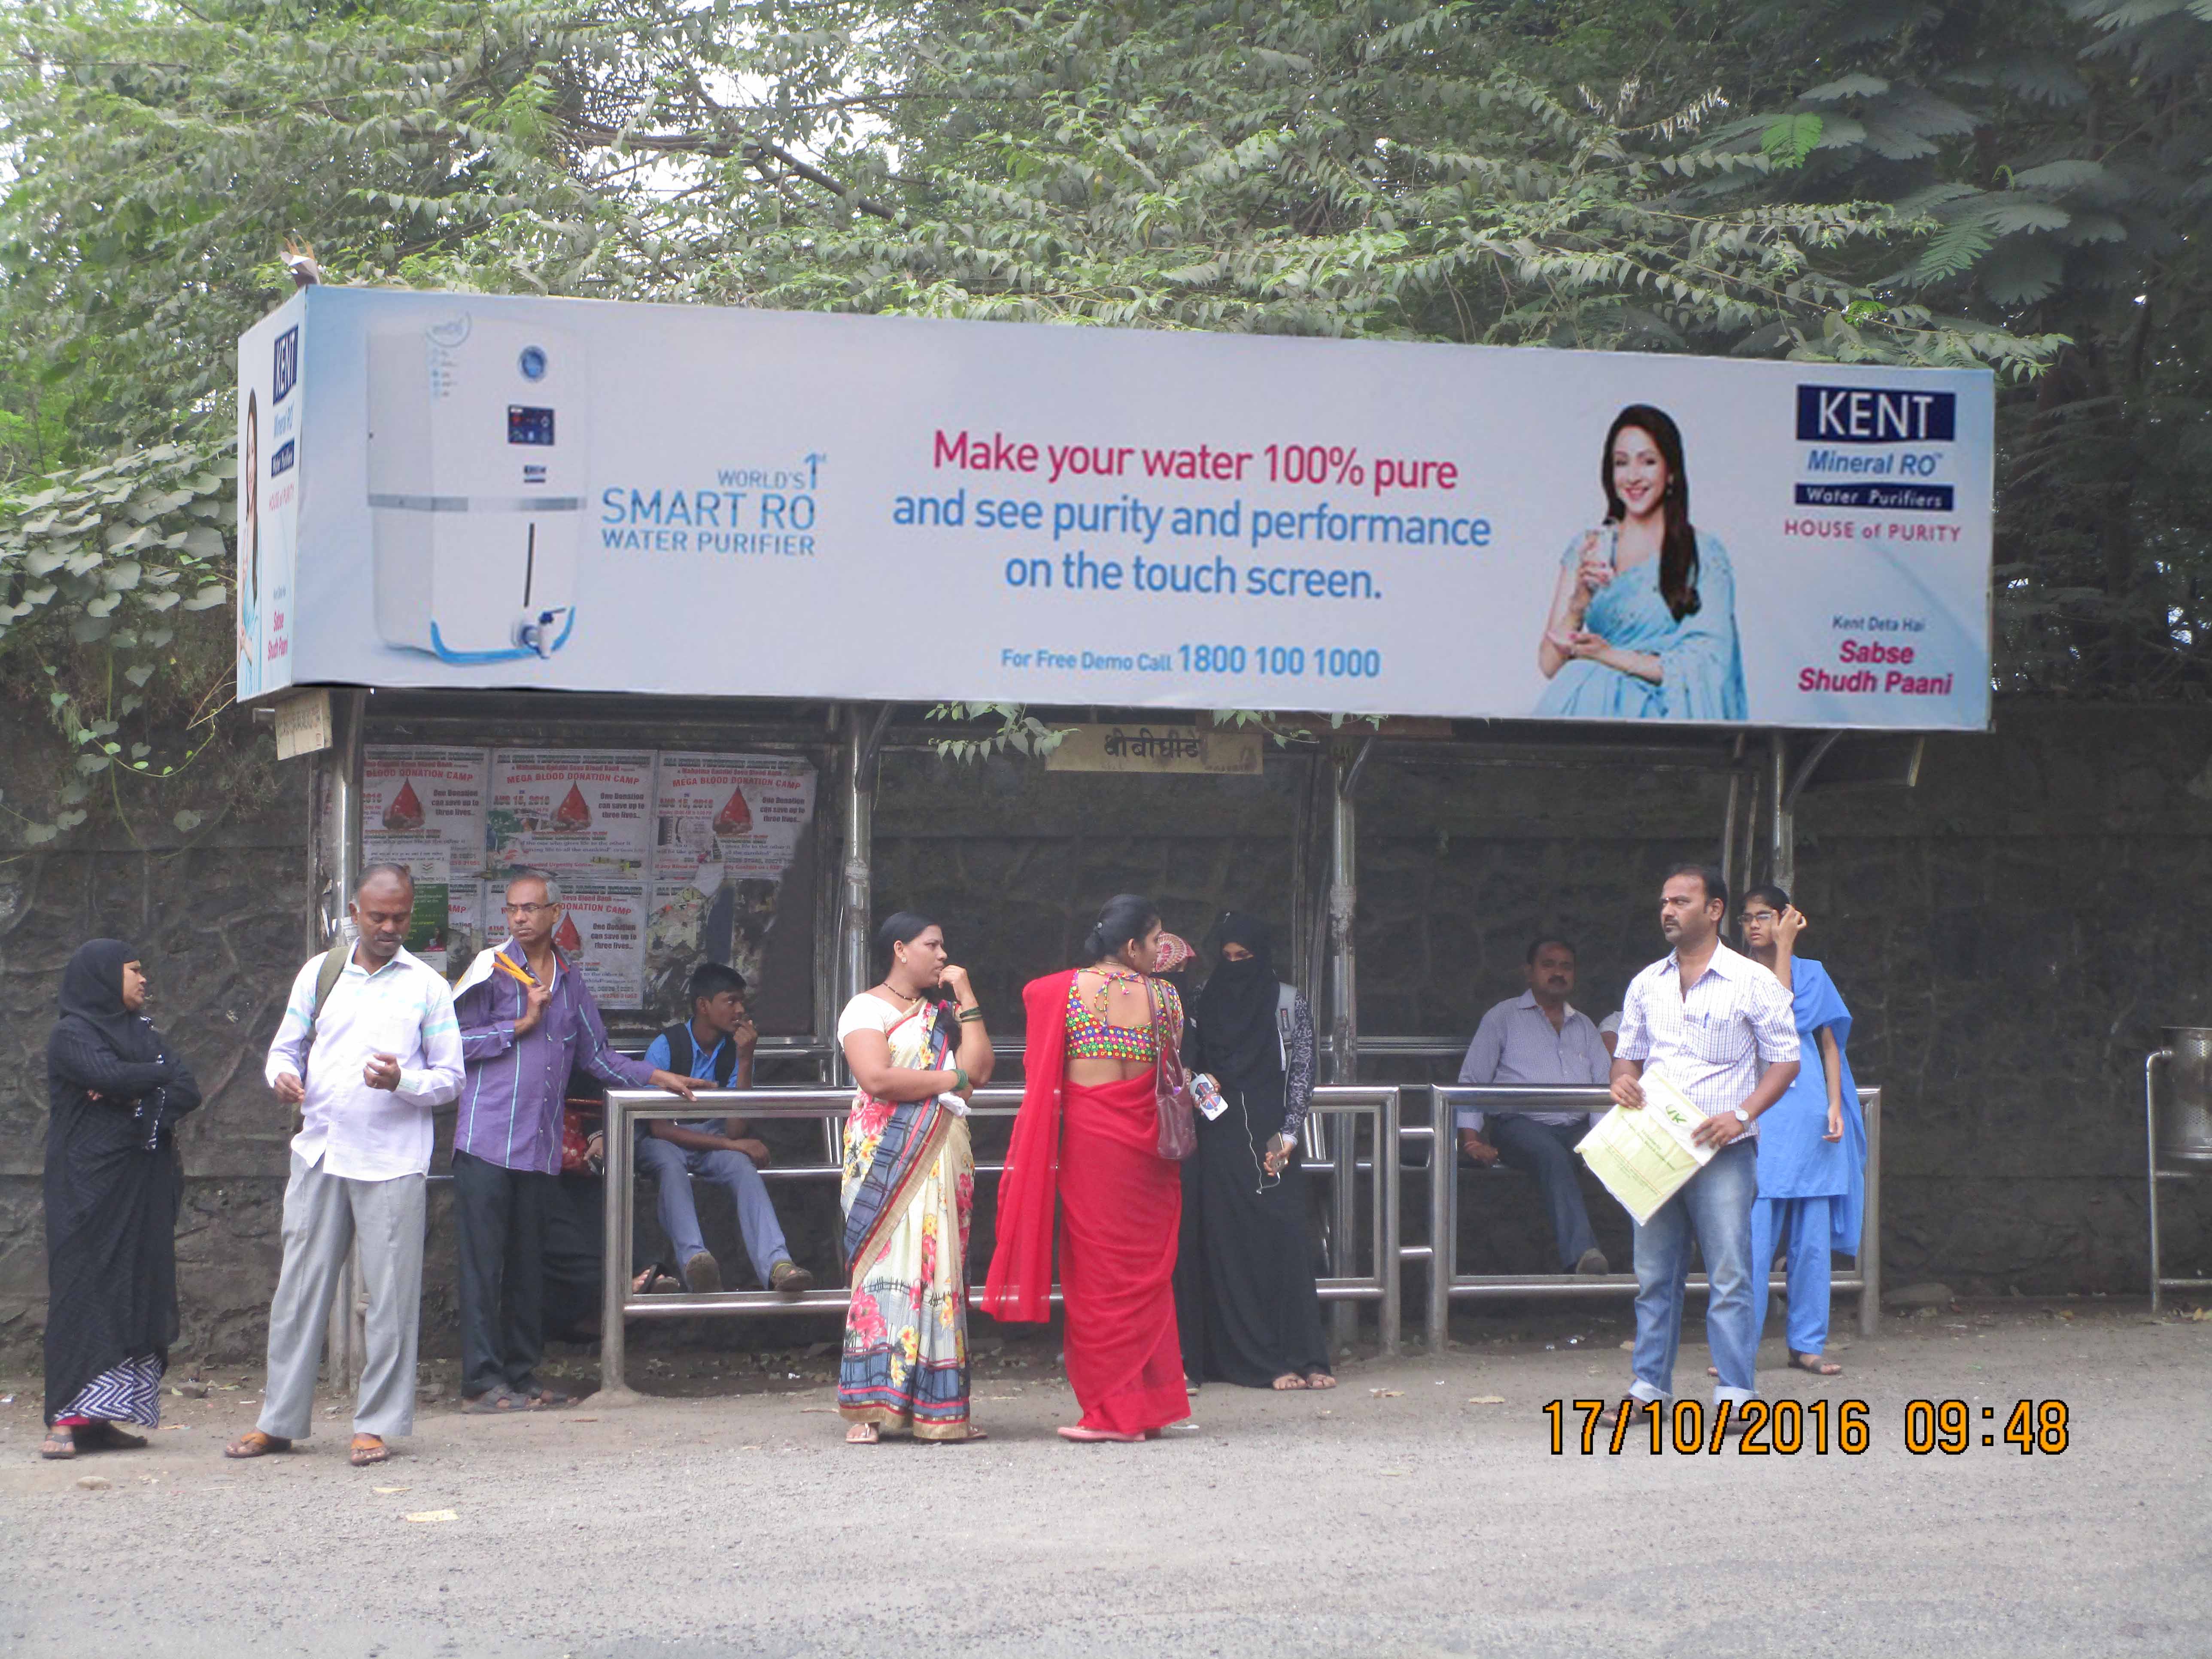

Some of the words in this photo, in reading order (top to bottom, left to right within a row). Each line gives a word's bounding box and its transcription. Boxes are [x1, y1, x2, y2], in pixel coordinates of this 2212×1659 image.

[276, 330, 295, 398] KENT
[1819, 391, 1933, 438] KENT
[933, 431, 1039, 474] Make
[1048, 446, 1134, 484] your
[1142, 445, 1253, 479] water
[1265, 445, 1365, 486] 100%
[1375, 459, 1458, 497] pure
[1808, 450, 1893, 474] Mineral
[717, 470, 805, 490] WORLD'S
[602, 488, 746, 528] SMART
[760, 493, 816, 530] RO
[1806, 487, 1859, 503] Water
[1868, 489, 1943, 507] Purifiers
[893, 489, 965, 526] and
[975, 499, 1043, 529] see
[1054, 495, 1164, 544] purity
[1171, 499, 1241, 537] and
[1252, 503, 1492, 548] performance
[1784, 520, 1854, 539] HOUSE
[1862, 524, 1881, 539] of
[1889, 523, 1961, 541] PURITY
[602, 529, 688, 552] WATER
[696, 531, 817, 556] PURIFIER
[1005, 558, 1051, 586] on
[1063, 550, 1123, 590] the
[1133, 555, 1236, 593] touch
[1247, 566, 1382, 599] screen.
[273, 610, 284, 632] Sabse
[1832, 616, 1865, 630] Kent
[1868, 617, 1899, 631] Deta
[1902, 618, 1925, 632] Hai
[1002, 649, 1031, 667] For
[1036, 650, 1076, 668] Free
[1081, 651, 1133, 671] Demo
[1138, 653, 1171, 672] Call
[1179, 644, 1246, 673] 1800
[1257, 645, 1304, 676] 100
[1314, 648, 1381, 678] 1000
[1839, 640, 1915, 664] Sabse
[1798, 668, 1877, 693] Shudh
[1885, 671, 1954, 696] Paani
[366, 769, 395, 778] BLOOD
[399, 769, 444, 778] DONATION
[446, 772, 474, 781] CAMP
[507, 774, 533, 784] MEGA
[567, 773, 611, 781] DONATION
[613, 775, 639, 784] CAMP
[673, 778, 697, 787] MEGA
[731, 777, 773, 786] DONATION
[775, 780, 801, 790] CAMP
[559, 903, 603, 912] DONATION
[606, 905, 632, 915] CAMP
